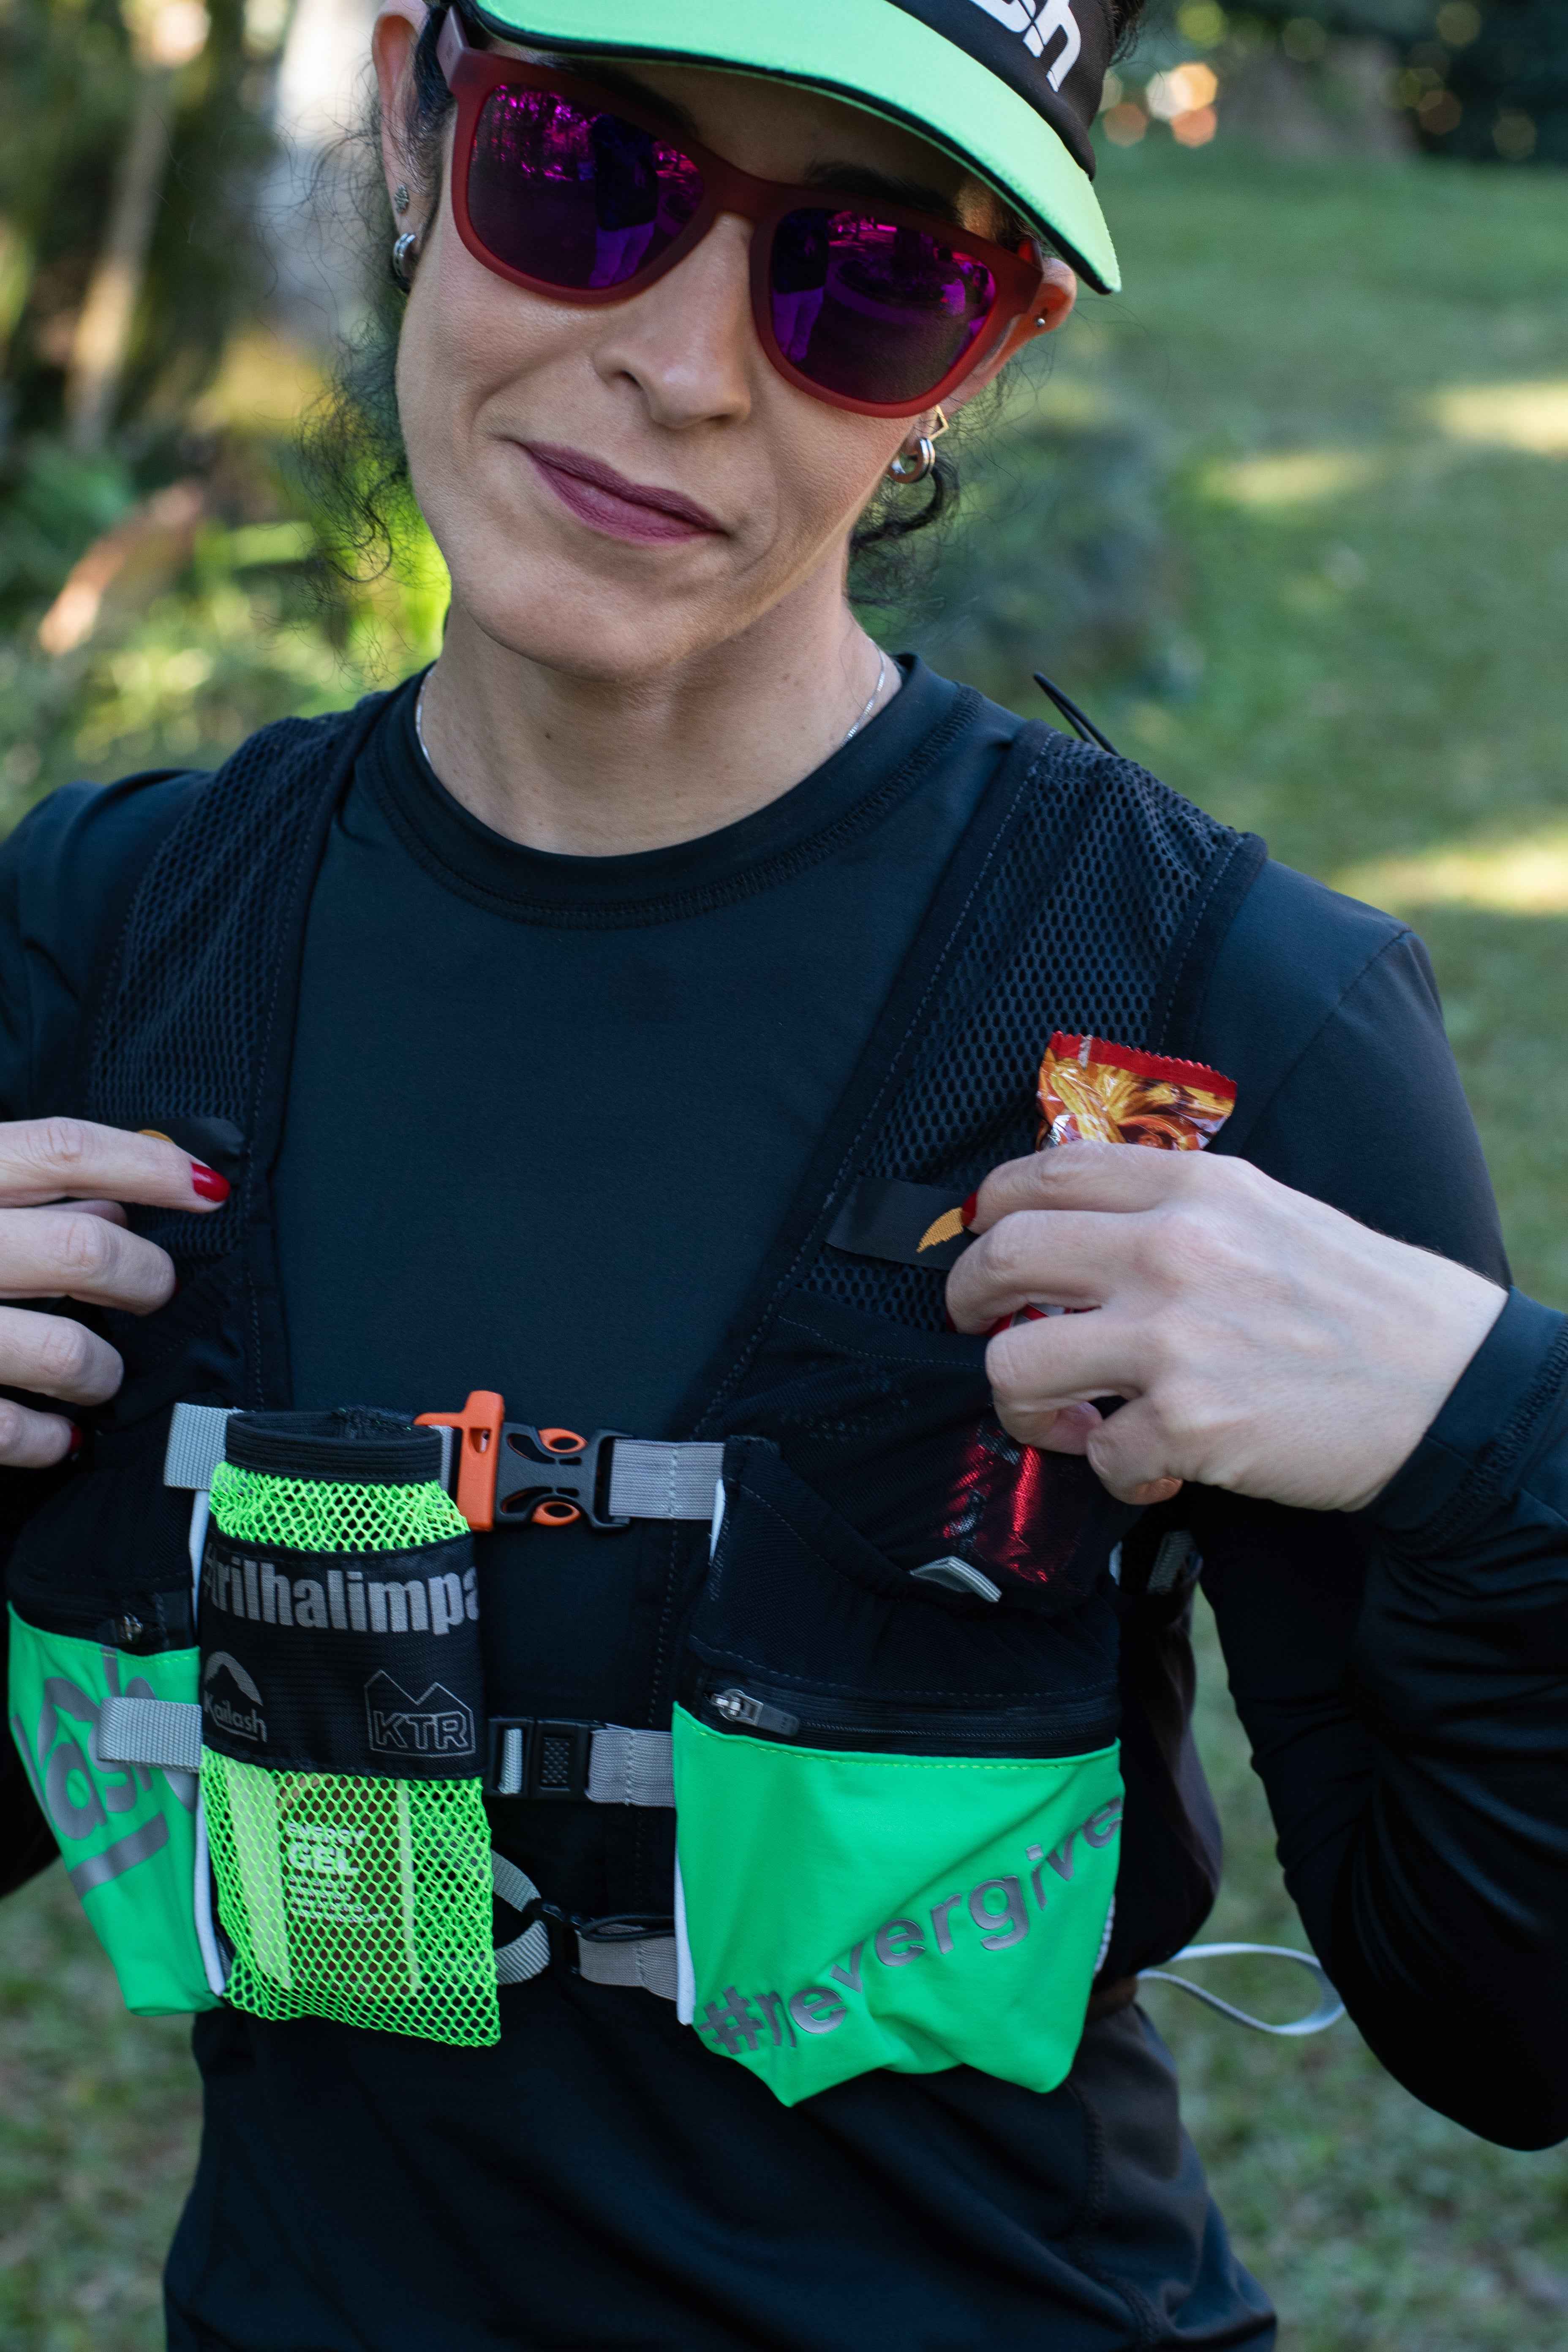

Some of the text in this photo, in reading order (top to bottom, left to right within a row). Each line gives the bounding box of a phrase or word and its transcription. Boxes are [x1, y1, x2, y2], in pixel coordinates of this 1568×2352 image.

[203, 1690, 267, 1742] Kailash
[373, 1710, 469, 1750] KTR
[288, 1842, 360, 1876] GEL
